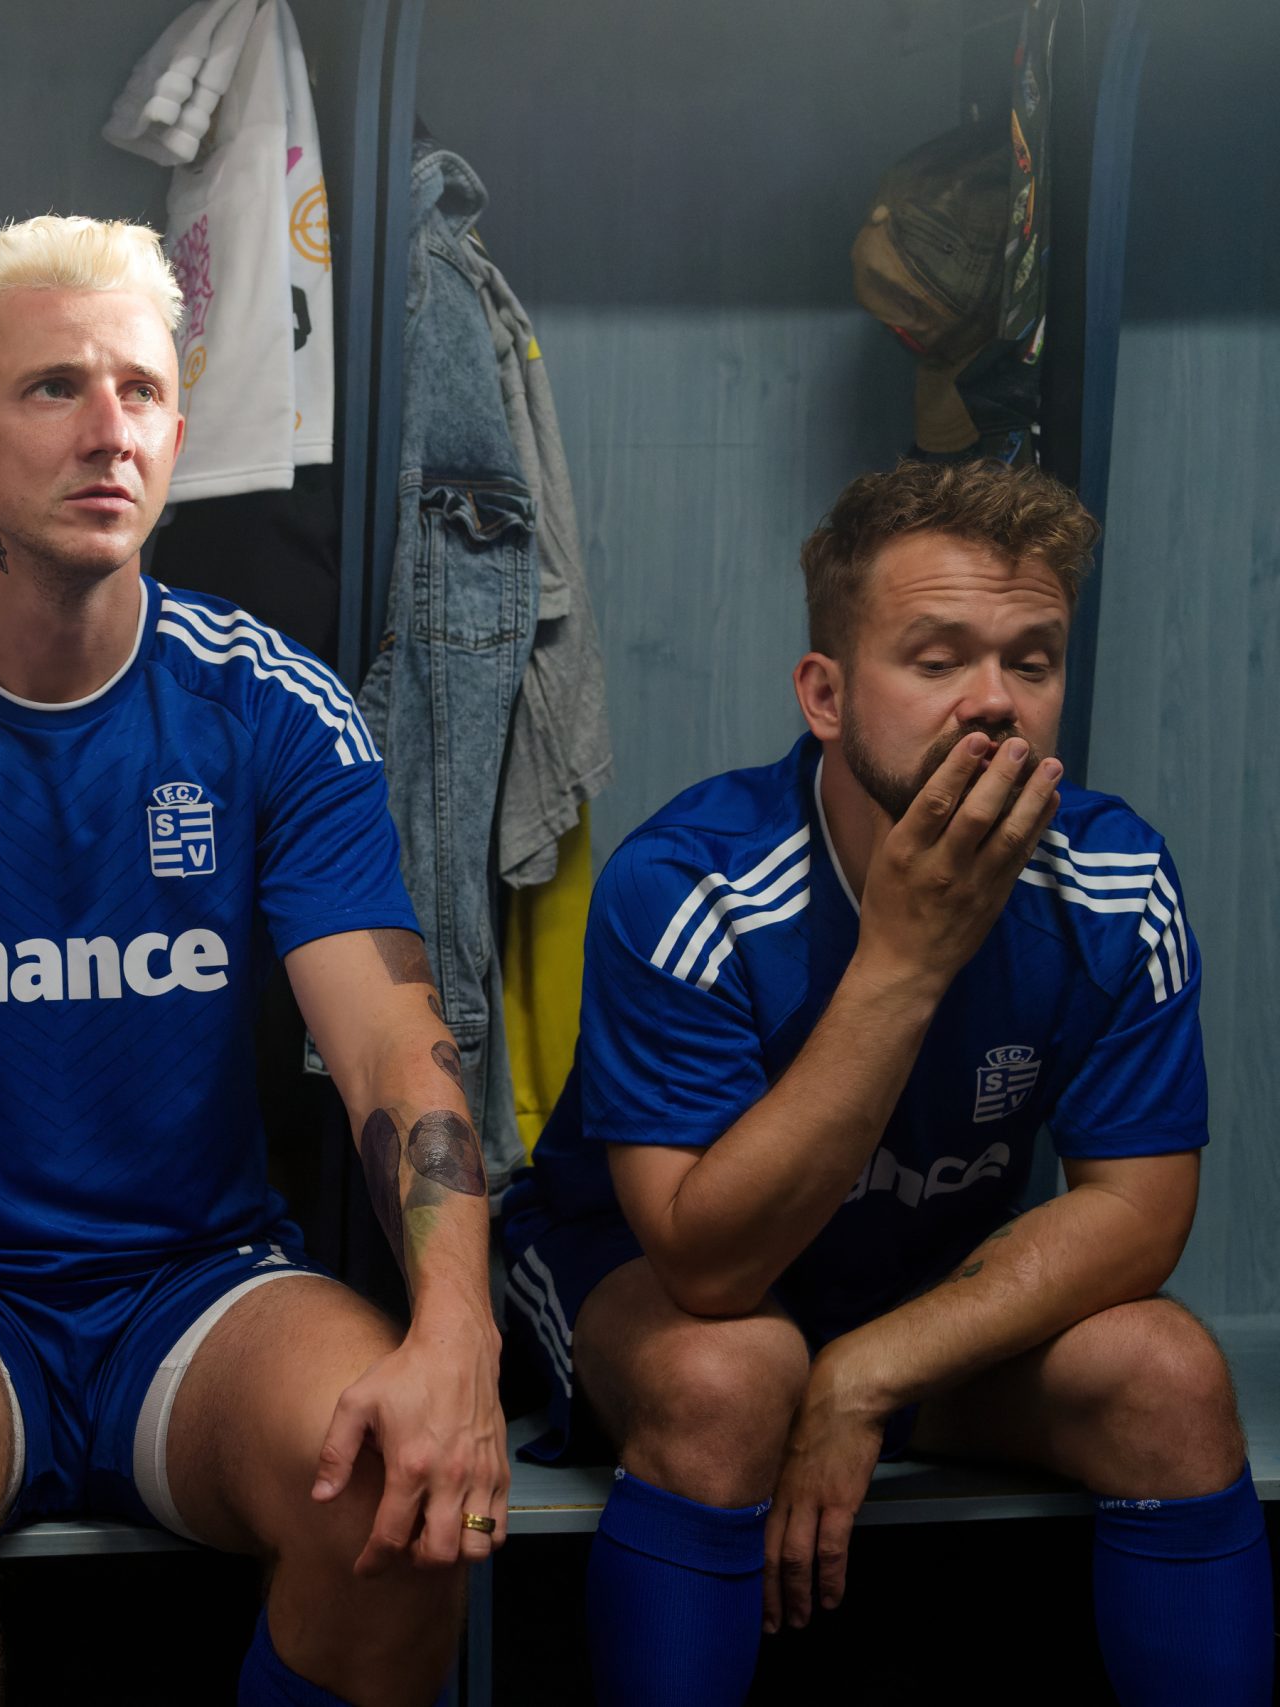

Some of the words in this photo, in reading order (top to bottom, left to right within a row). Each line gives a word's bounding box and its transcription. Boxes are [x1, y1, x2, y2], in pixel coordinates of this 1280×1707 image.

[162, 786, 194, 802] F.C.
[156, 813, 175, 837] S
[187, 844, 207, 867] V
[984, 1072, 1003, 1092] S
